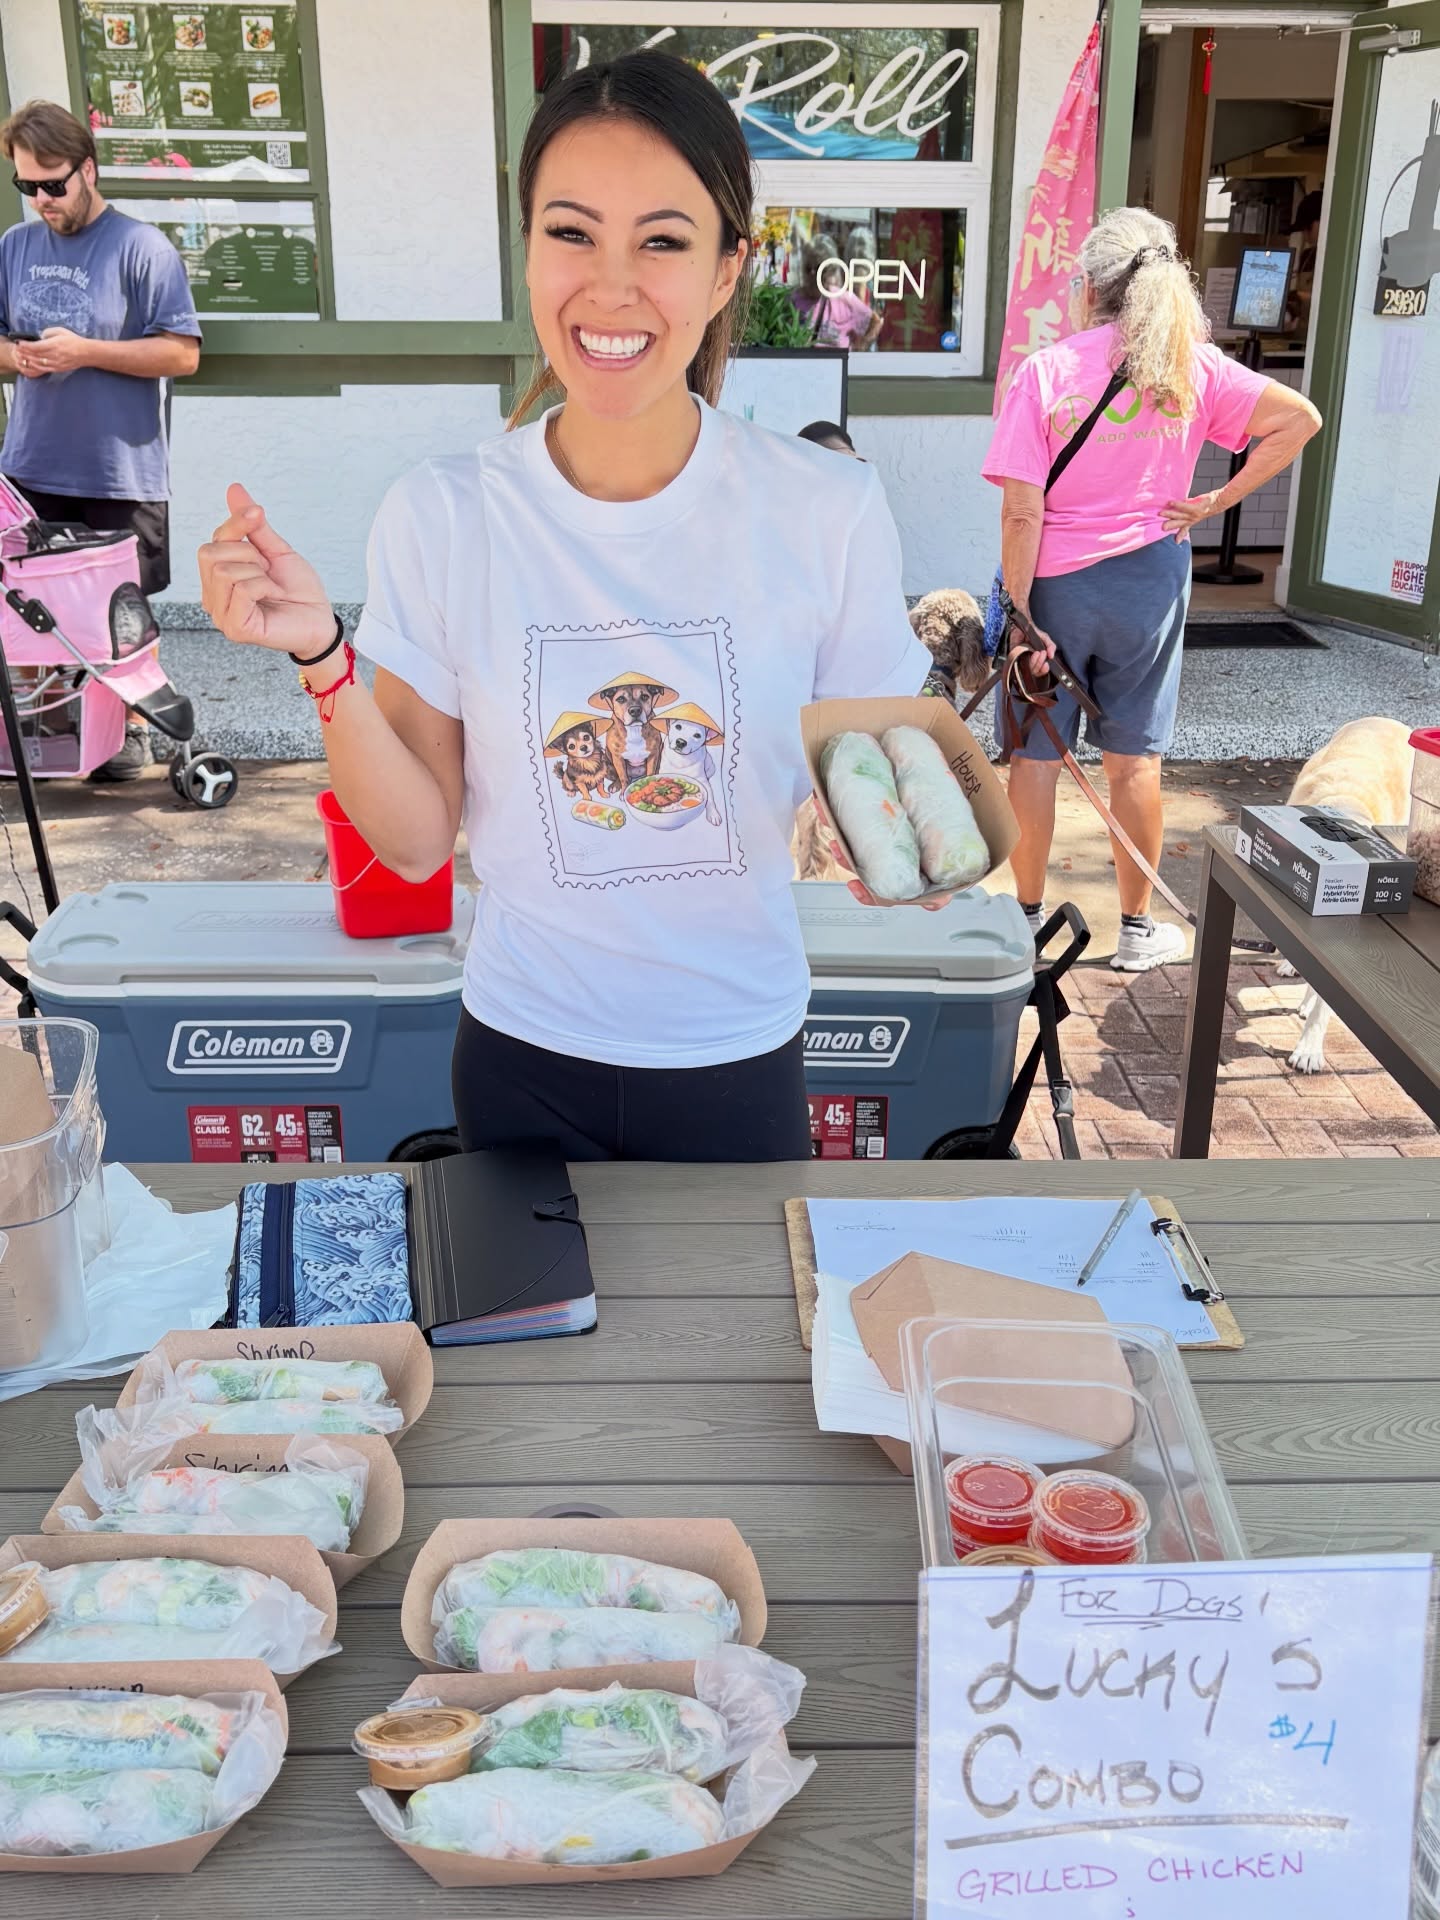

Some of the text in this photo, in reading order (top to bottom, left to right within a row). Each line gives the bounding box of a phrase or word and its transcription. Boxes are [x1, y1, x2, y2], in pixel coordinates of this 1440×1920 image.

[706, 33, 969, 156] Roll
[816, 257, 926, 300] OPEN
[1382, 289, 1426, 315] 2930
[1394, 560, 1404, 568] WE
[951, 750, 982, 800] House
[1240, 839, 1246, 853] S
[1375, 890, 1389, 898] 100
[1394, 892, 1402, 902] S
[187, 1028, 305, 1059] Coleman
[195, 1126, 231, 1135] CLASSIC
[241, 1114, 263, 1137] 62
[1059, 1577, 1243, 1618] FOR DOGS
[1268, 1714, 1336, 1766] $4
[962, 1723, 1204, 1819] COMBO
[957, 1850, 1304, 1902] GRILLED CHICKEN
